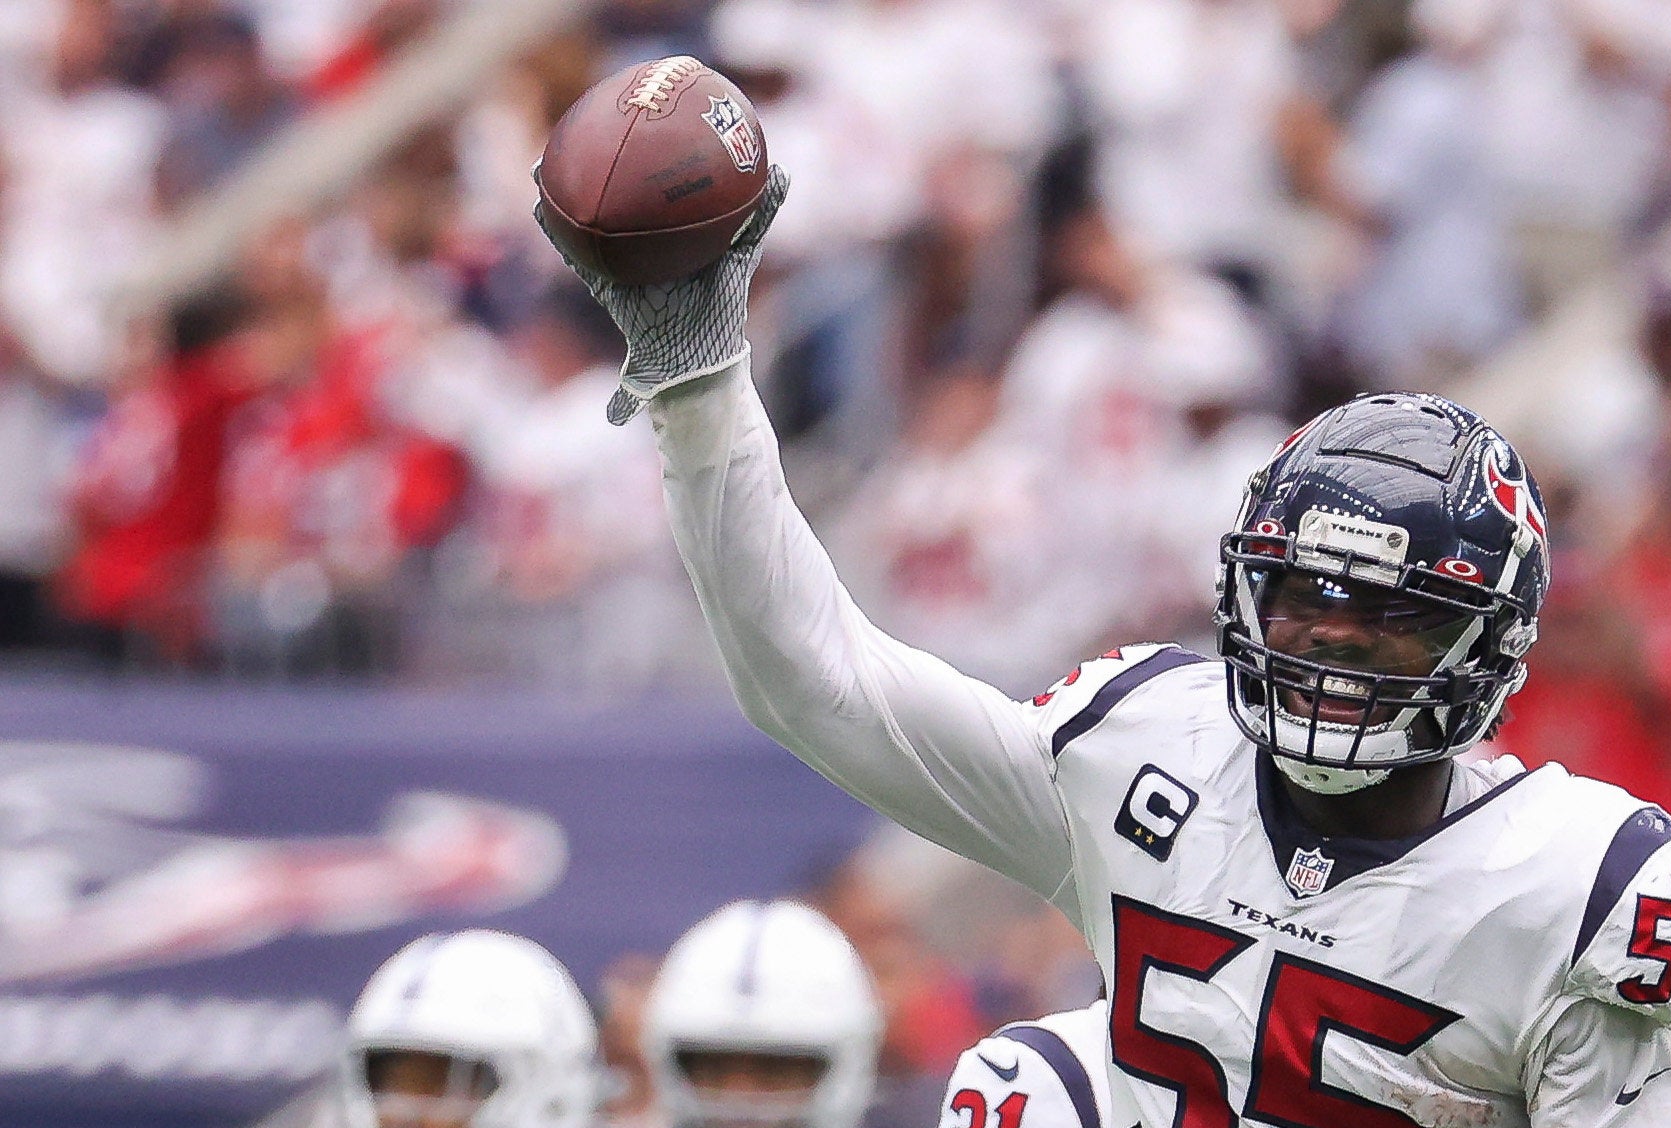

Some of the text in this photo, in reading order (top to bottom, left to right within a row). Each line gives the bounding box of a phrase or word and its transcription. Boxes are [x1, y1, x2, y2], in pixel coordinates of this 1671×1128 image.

[1331, 522, 1383, 539] TEXANS
[1129, 772, 1191, 840] C
[1292, 865, 1320, 889] NFL
[1227, 898, 1338, 949] TEXANS
